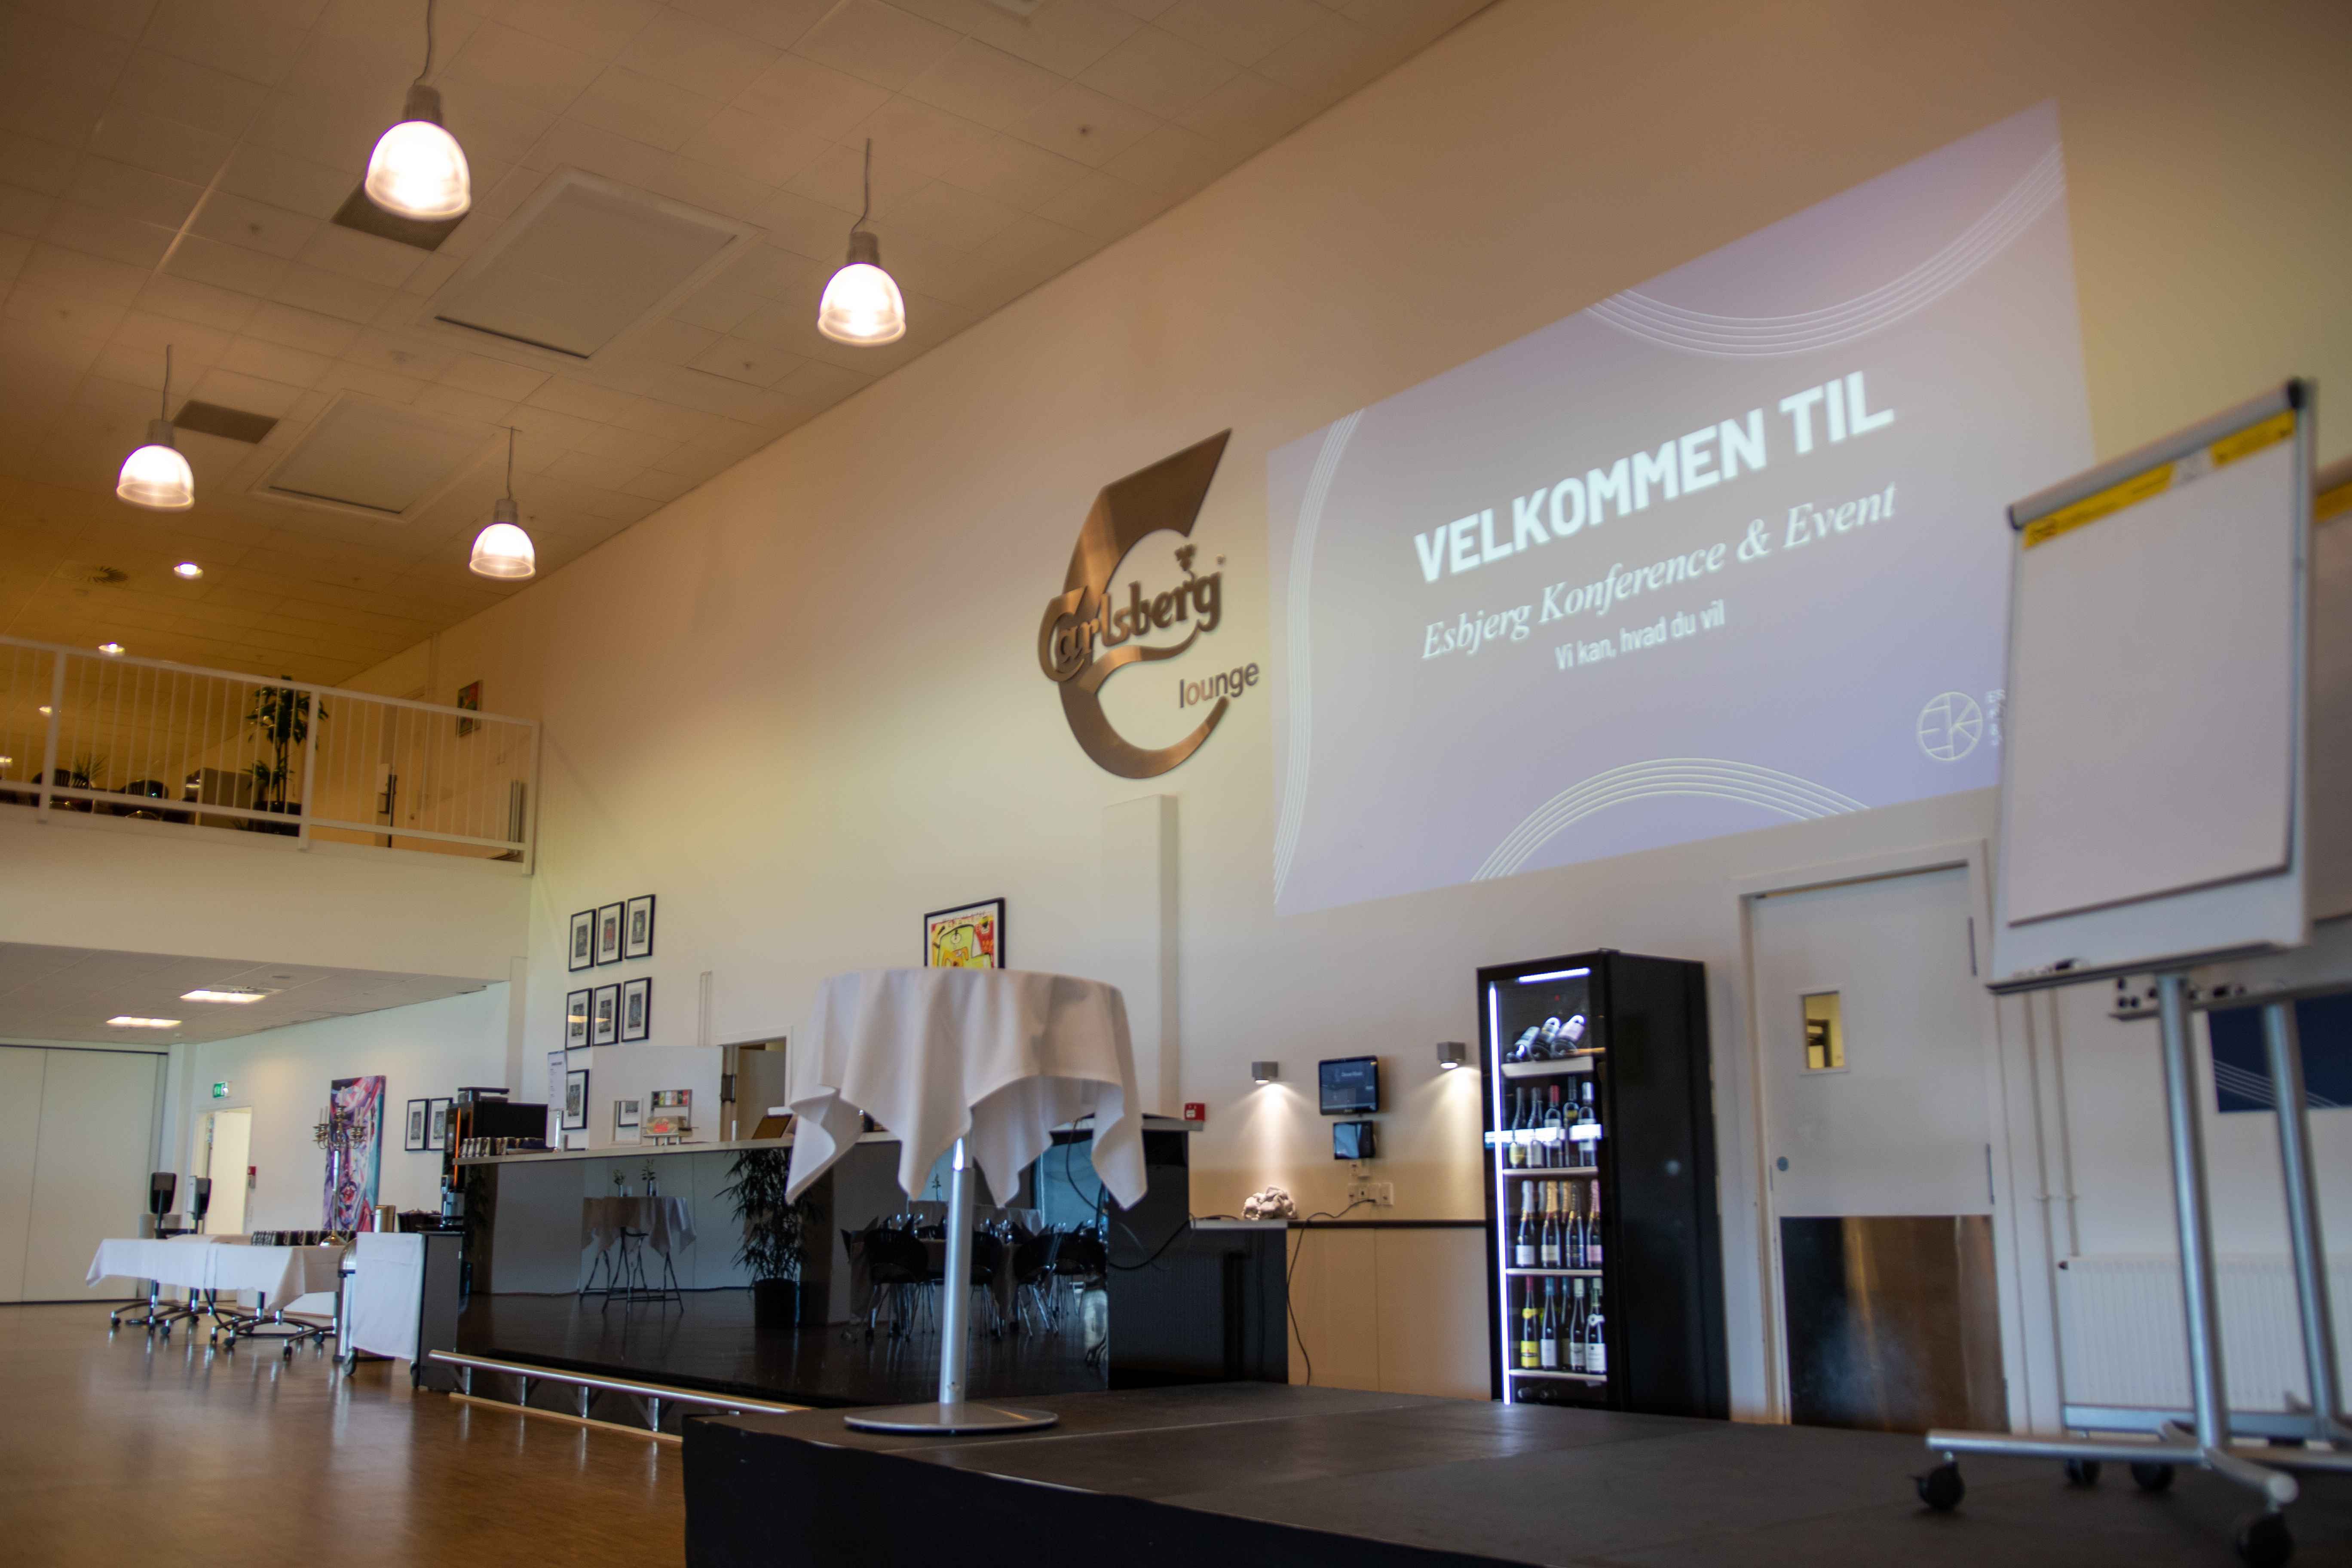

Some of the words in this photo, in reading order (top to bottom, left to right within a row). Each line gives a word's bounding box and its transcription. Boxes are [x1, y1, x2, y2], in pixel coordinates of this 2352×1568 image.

[1414, 408, 1767, 582] VELKOMMEN
[1779, 370, 1895, 453] TIL
[1421, 603, 1531, 659] Esbjerg
[1539, 541, 1726, 624] Konference
[1737, 518, 1771, 561] &
[1783, 482, 1896, 548] Event
[1038, 572, 1222, 682] Carlsberg
[1555, 644, 1574, 670] Vi
[1577, 638, 1617, 665] kan,
[1620, 616, 1666, 652] hvad
[1670, 610, 1697, 639] du
[1700, 599, 1725, 629] vil
[1180, 662, 1259, 708] lounge
